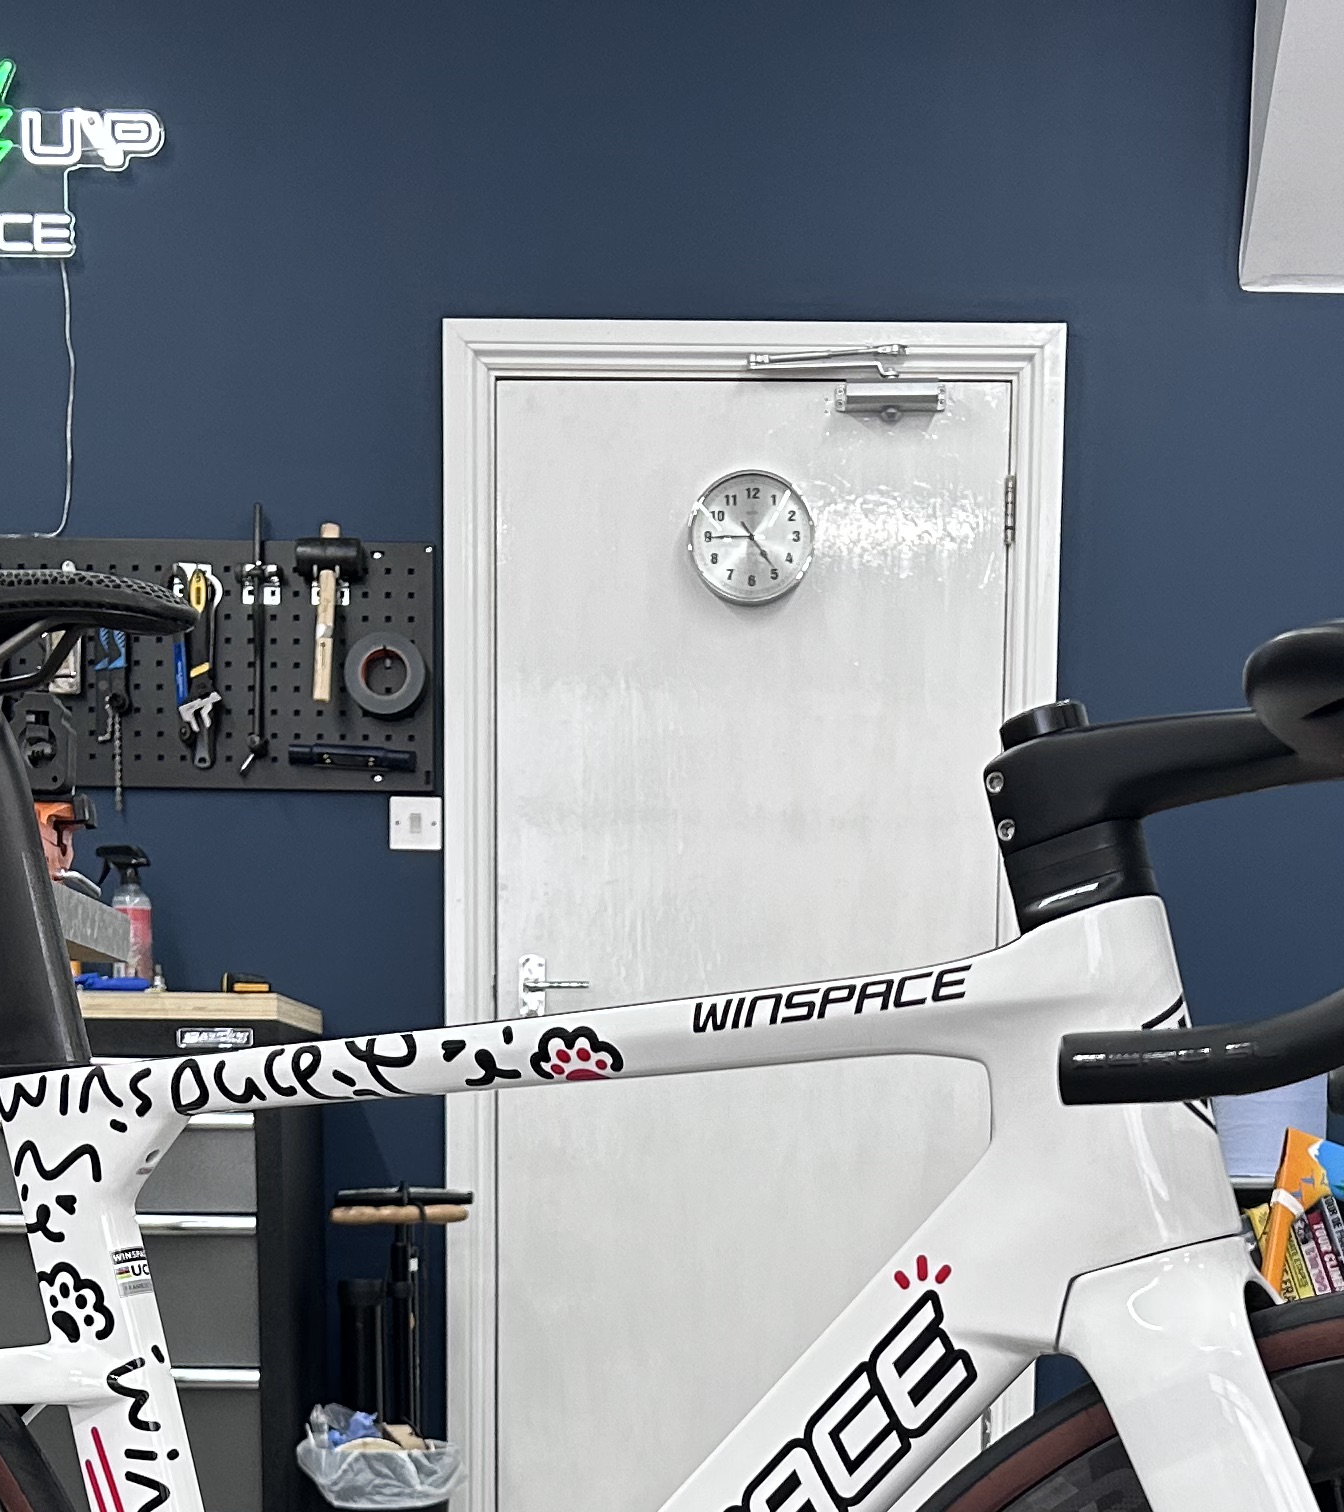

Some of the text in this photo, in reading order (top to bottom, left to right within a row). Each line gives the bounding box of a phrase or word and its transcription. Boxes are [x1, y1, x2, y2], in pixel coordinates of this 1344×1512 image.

[19, 107, 164, 166] UP
[745, 487, 761, 500] 12
[724, 494, 737, 506] 11
[770, 494, 777, 506] 1
[787, 510, 796, 522] 2
[791, 531, 801, 542] 3
[710, 552, 718, 565] 8
[785, 552, 793, 564] 4
[726, 569, 734, 581] 7
[770, 568, 779, 580] 5
[747, 575, 756, 587] 6
[691, 963, 973, 1034] WINSPACE
